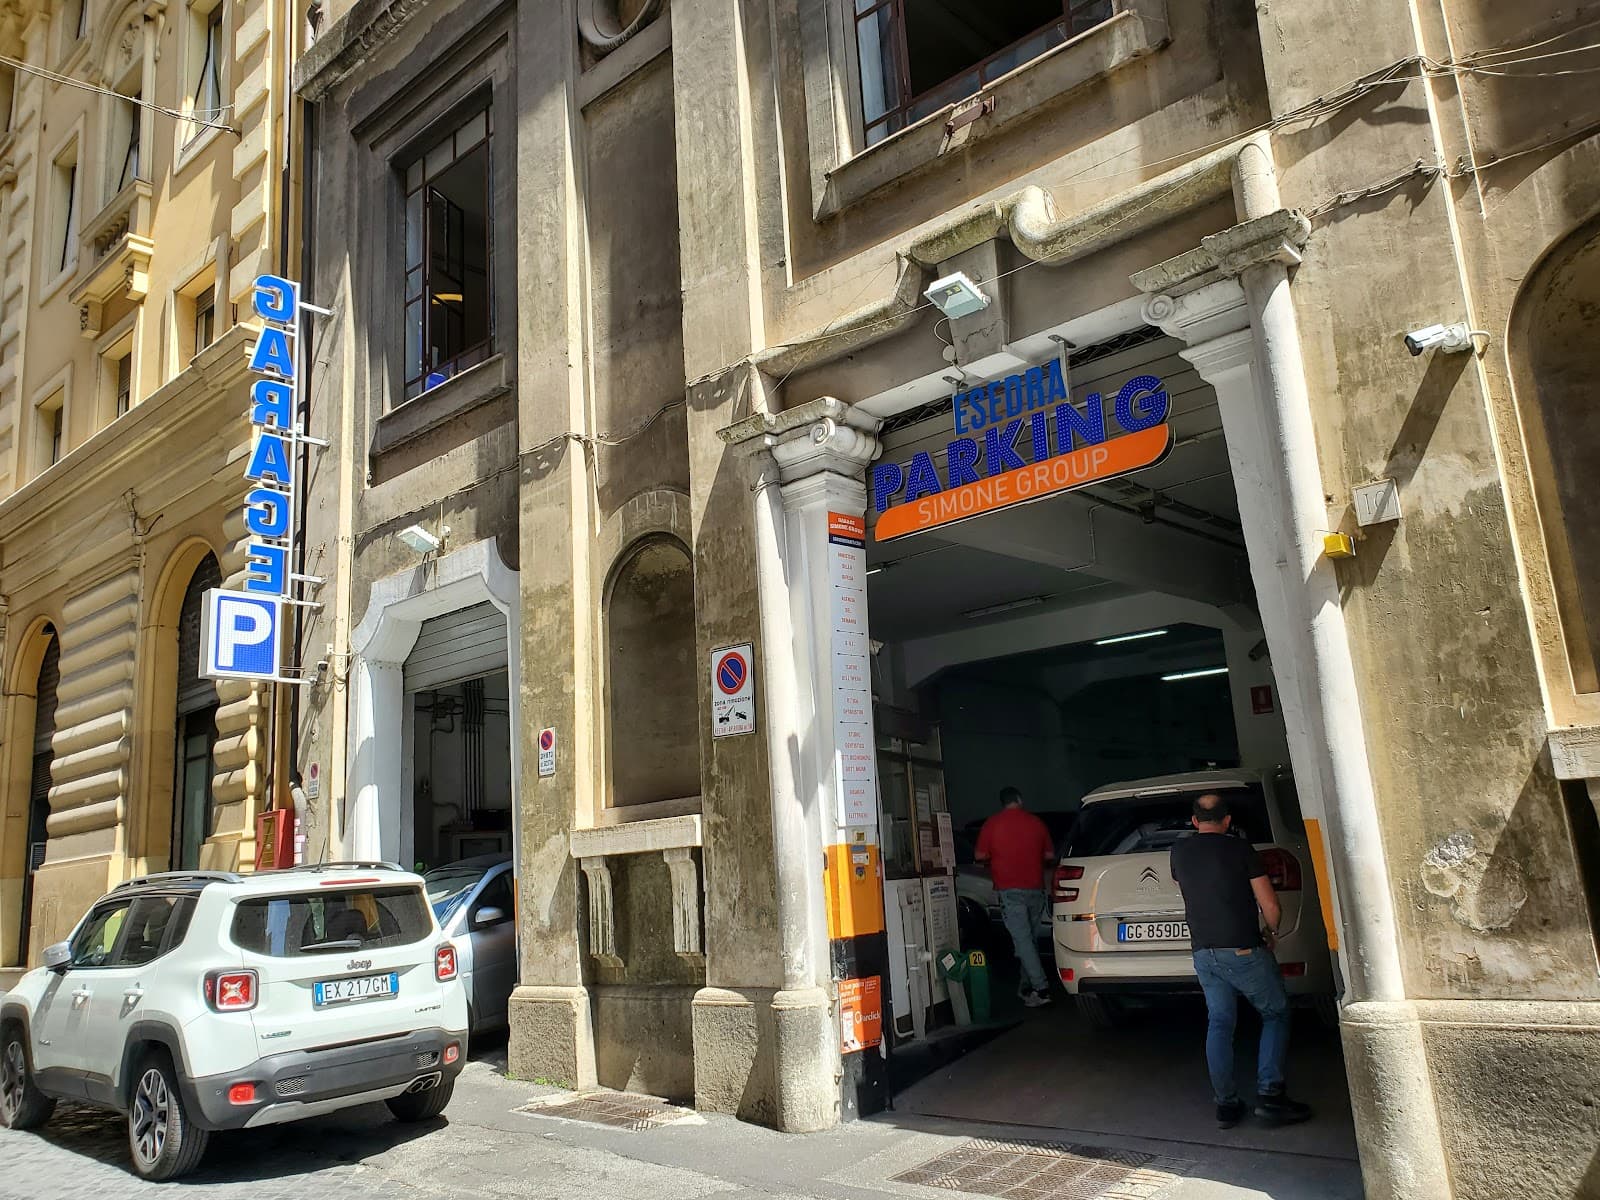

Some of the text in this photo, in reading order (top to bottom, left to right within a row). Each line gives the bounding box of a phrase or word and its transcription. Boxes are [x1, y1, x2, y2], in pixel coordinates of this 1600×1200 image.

[954, 358, 1068, 434] ESEDRA
[873, 375, 1171, 512] PARKING
[918, 447, 1110, 526] SIMONE GROUP
[217, 599, 273, 668] P
[1127, 923, 1189, 939] GG 859DE
[347, 959, 372, 970] Jeep
[973, 953, 983, 964] 20
[324, 976, 389, 1000] EX 217GM
